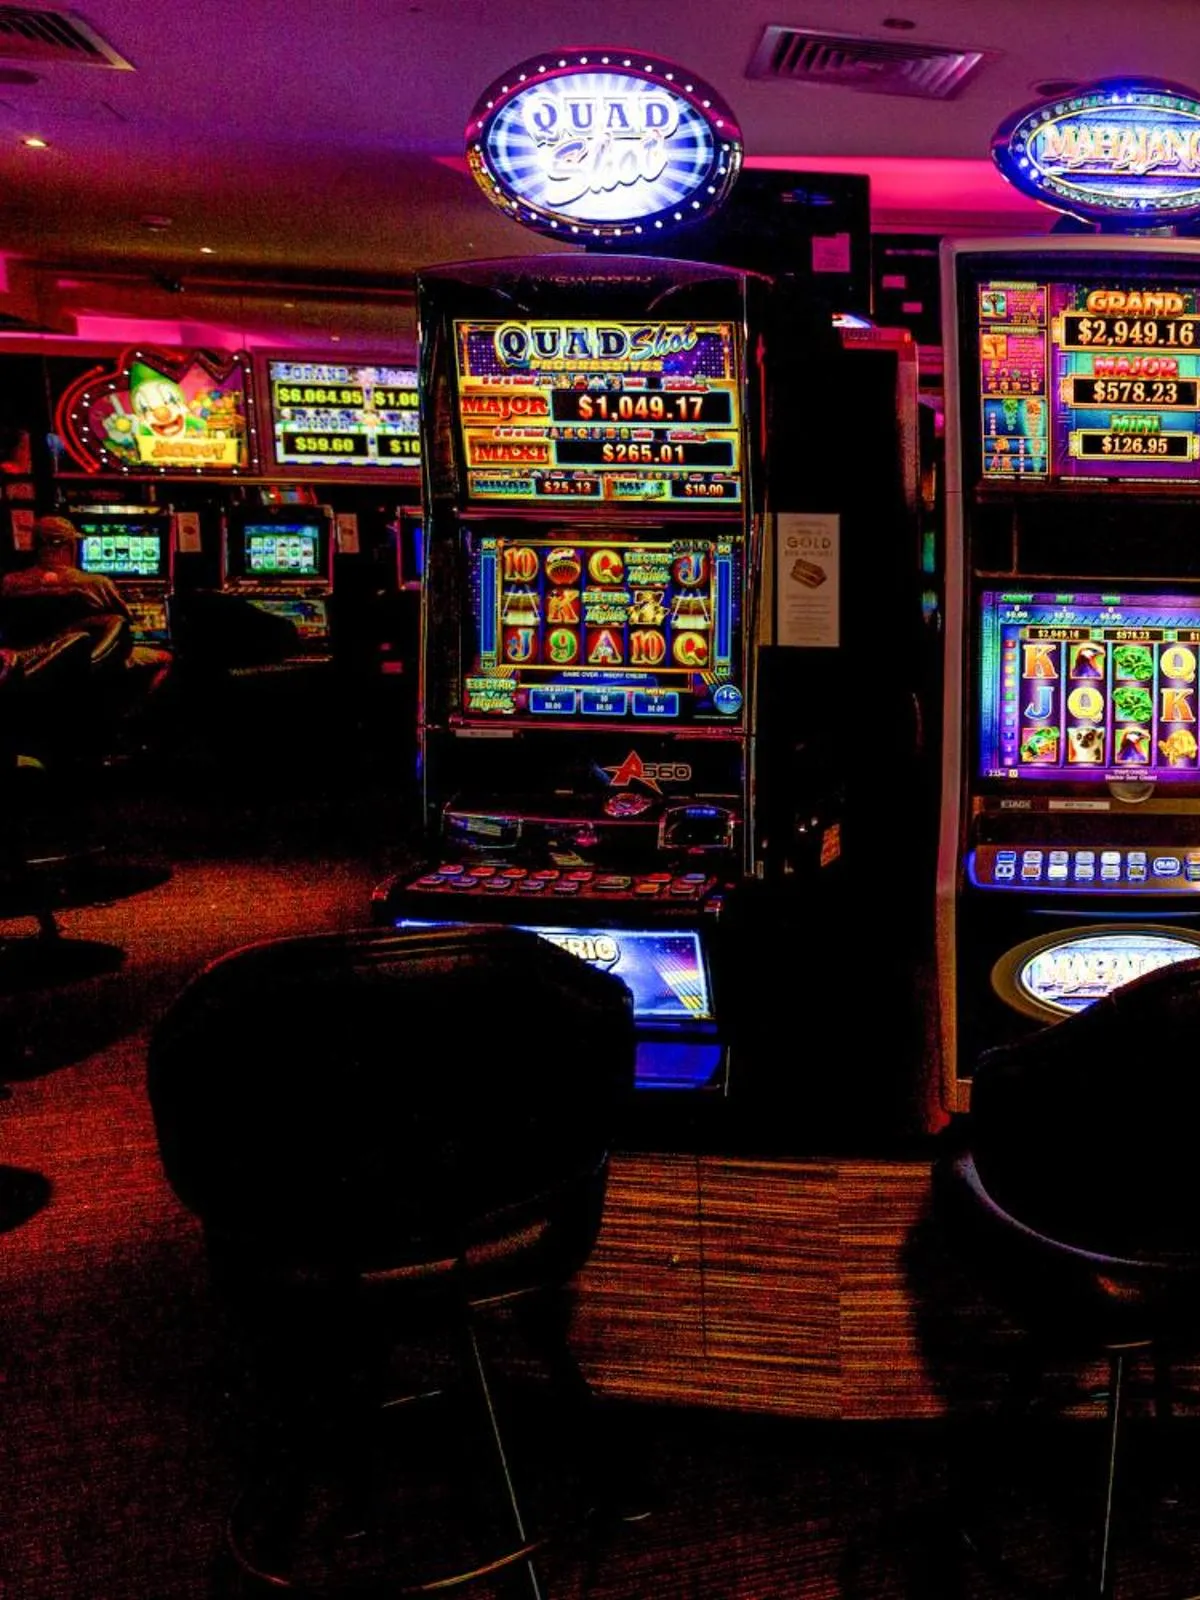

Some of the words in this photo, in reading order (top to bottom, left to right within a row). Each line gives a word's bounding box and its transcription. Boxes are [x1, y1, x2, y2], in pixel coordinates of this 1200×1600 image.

[532, 102, 672, 142] QUAD
[547, 130, 668, 204] Shot
[1087, 290, 1186, 315] GRAND
[498, 324, 628, 367] QUAD
[629, 323, 698, 361] Shot
[1077, 317, 1195, 346] $2,949.16
[1093, 356, 1180, 378] MAJOR
[461, 395, 548, 420] MAJOR
[578, 394, 704, 422] $1,049.17
[1093, 381, 1178, 404] $578.23
[1110, 414, 1161, 434] MINI
[295, 436, 354, 452] $59.60
[602, 444, 686, 463] $265.01
[1101, 435, 1169, 455] $126.95
[543, 481, 592, 494] $25.13
[684, 484, 724, 496] $10.00
[786, 536, 832, 550] GOLD
[504, 548, 538, 582] 10
[588, 548, 624, 585] Q
[550, 628, 578, 663] 9
[630, 628, 666, 664] 10
[673, 631, 709, 667] Q
[1022, 644, 1058, 679] K
[1160, 647, 1196, 683] Q
[1024, 686, 1054, 720] J
[1067, 687, 1104, 723] Q
[1160, 688, 1196, 722] K
